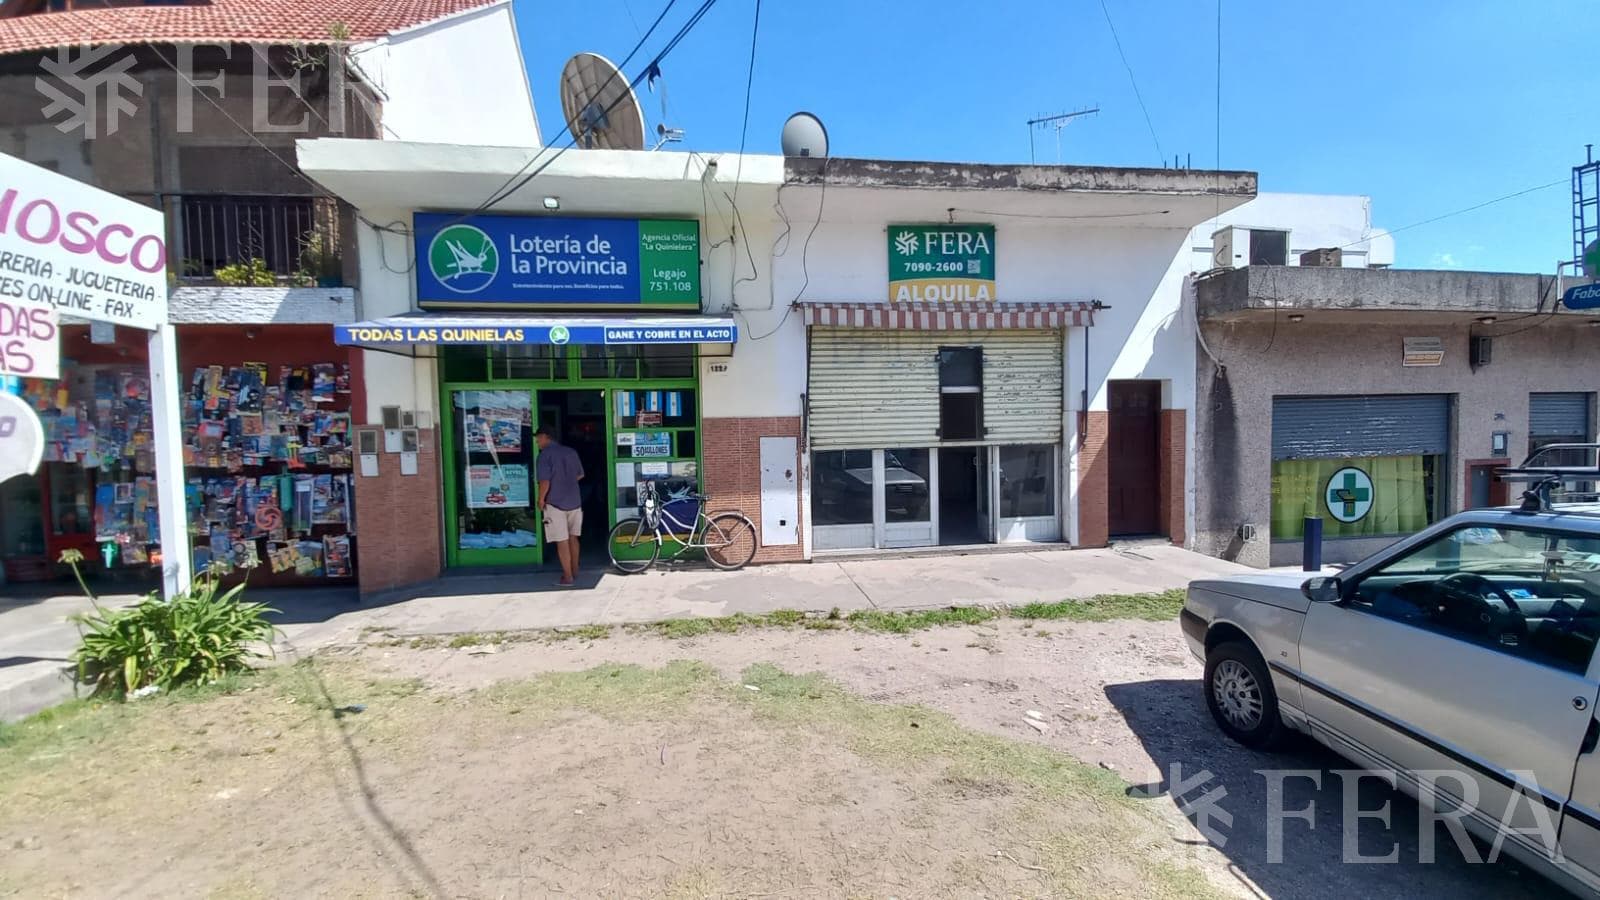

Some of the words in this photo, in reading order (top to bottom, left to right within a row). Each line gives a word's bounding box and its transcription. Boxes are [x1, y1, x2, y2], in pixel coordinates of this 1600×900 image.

[510, 233, 581, 254] Lotería
[586, 234, 611, 254] de
[641, 233, 670, 243] Agencia
[672, 233, 696, 241] Oficial
[923, 231, 990, 255] FERA
[511, 253, 531, 274] la
[536, 255, 627, 275] Provincia
[904, 262, 964, 272] 7090-2600
[0, 250, 53, 279] RERIA
[66, 267, 155, 301] JUGUETERIA
[653, 267, 687, 281] Legajo
[650, 281, 692, 291] 751.108
[895, 284, 992, 302] ALQUILA
[0, 276, 23, 298] ES
[104, 298, 134, 318] FAX
[347, 328, 403, 342] TODAS
[407, 328, 438, 342] LAS
[441, 328, 524, 342] QUINIELAS
[608, 331, 634, 340] GANE
[636, 331, 644, 339] Y
[645, 330, 677, 339] COBRE
[679, 330, 692, 339] EN
[693, 330, 705, 338] EL
[706, 330, 730, 338] ACTO
